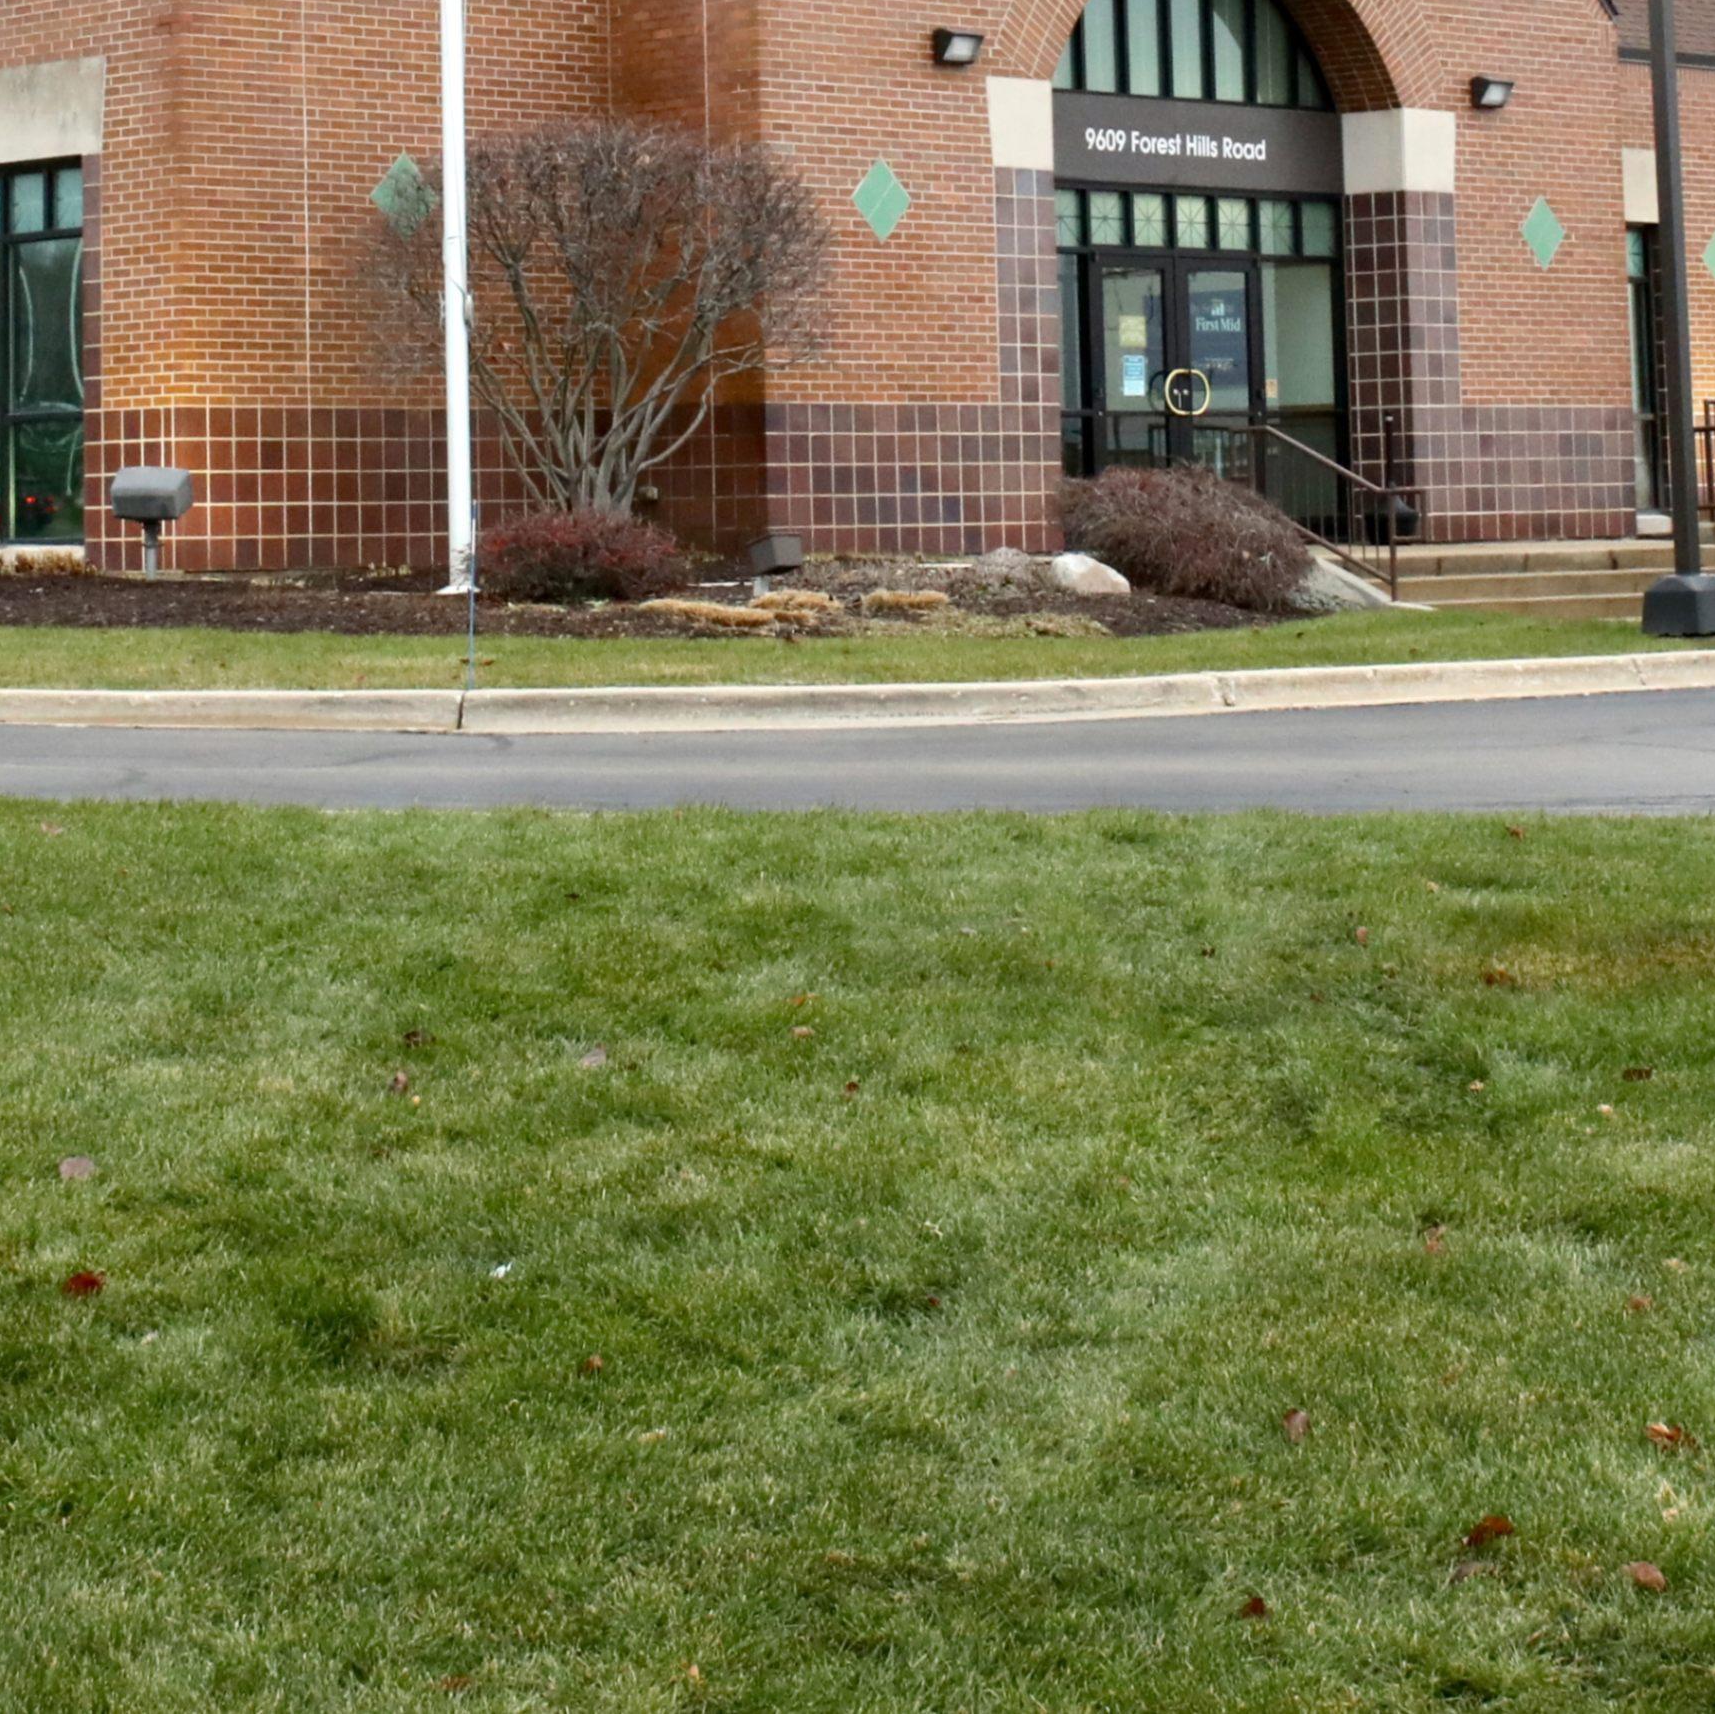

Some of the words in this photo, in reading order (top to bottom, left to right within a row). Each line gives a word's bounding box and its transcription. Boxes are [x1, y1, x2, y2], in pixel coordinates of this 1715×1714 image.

[1085, 127, 1126, 151] 9609
[1131, 131, 1182, 156] Forest
[1185, 134, 1218, 158] Hills
[1221, 137, 1266, 161] Road
[1195, 317, 1220, 332] First
[1221, 318, 1241, 332] Mid
